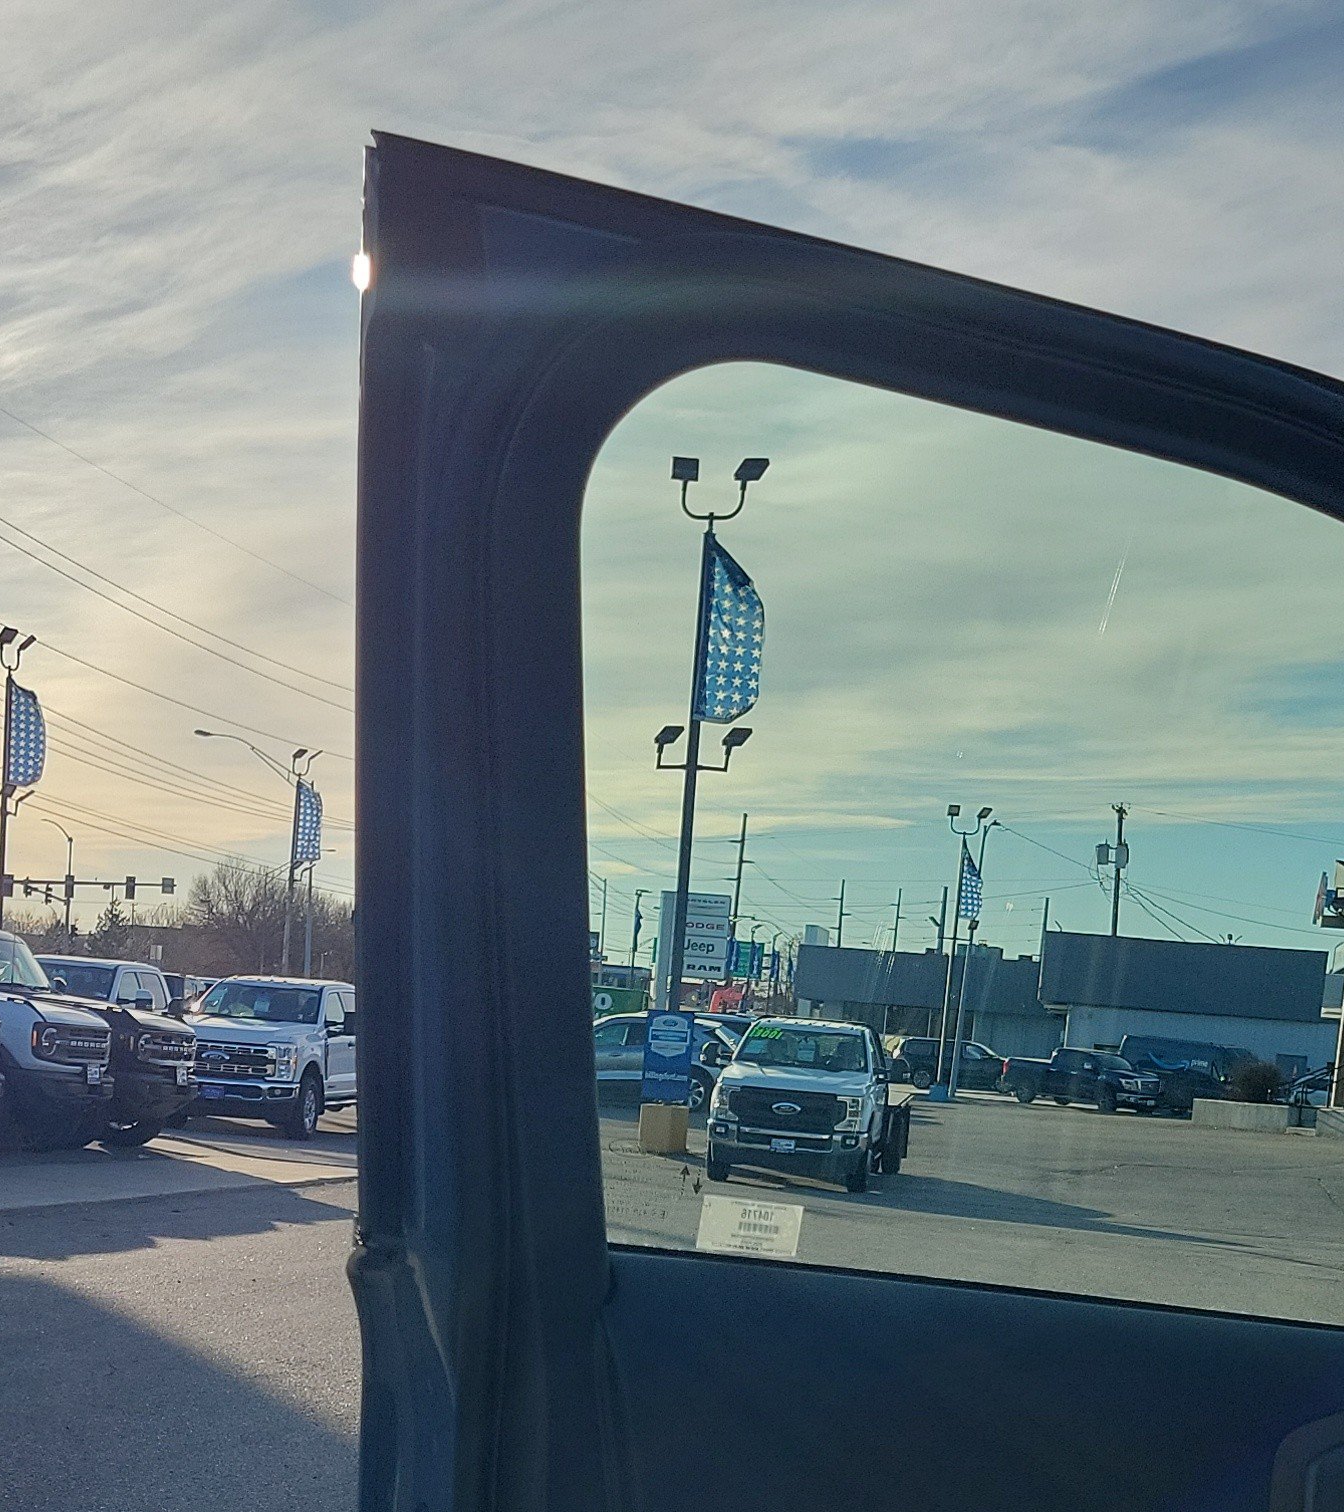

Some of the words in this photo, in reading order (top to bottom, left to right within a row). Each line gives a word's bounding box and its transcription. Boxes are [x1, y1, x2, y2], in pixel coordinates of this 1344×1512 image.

[685, 921, 725, 931] ODGE
[684, 938, 715, 955] Jeep
[686, 963, 722, 973] RAM
